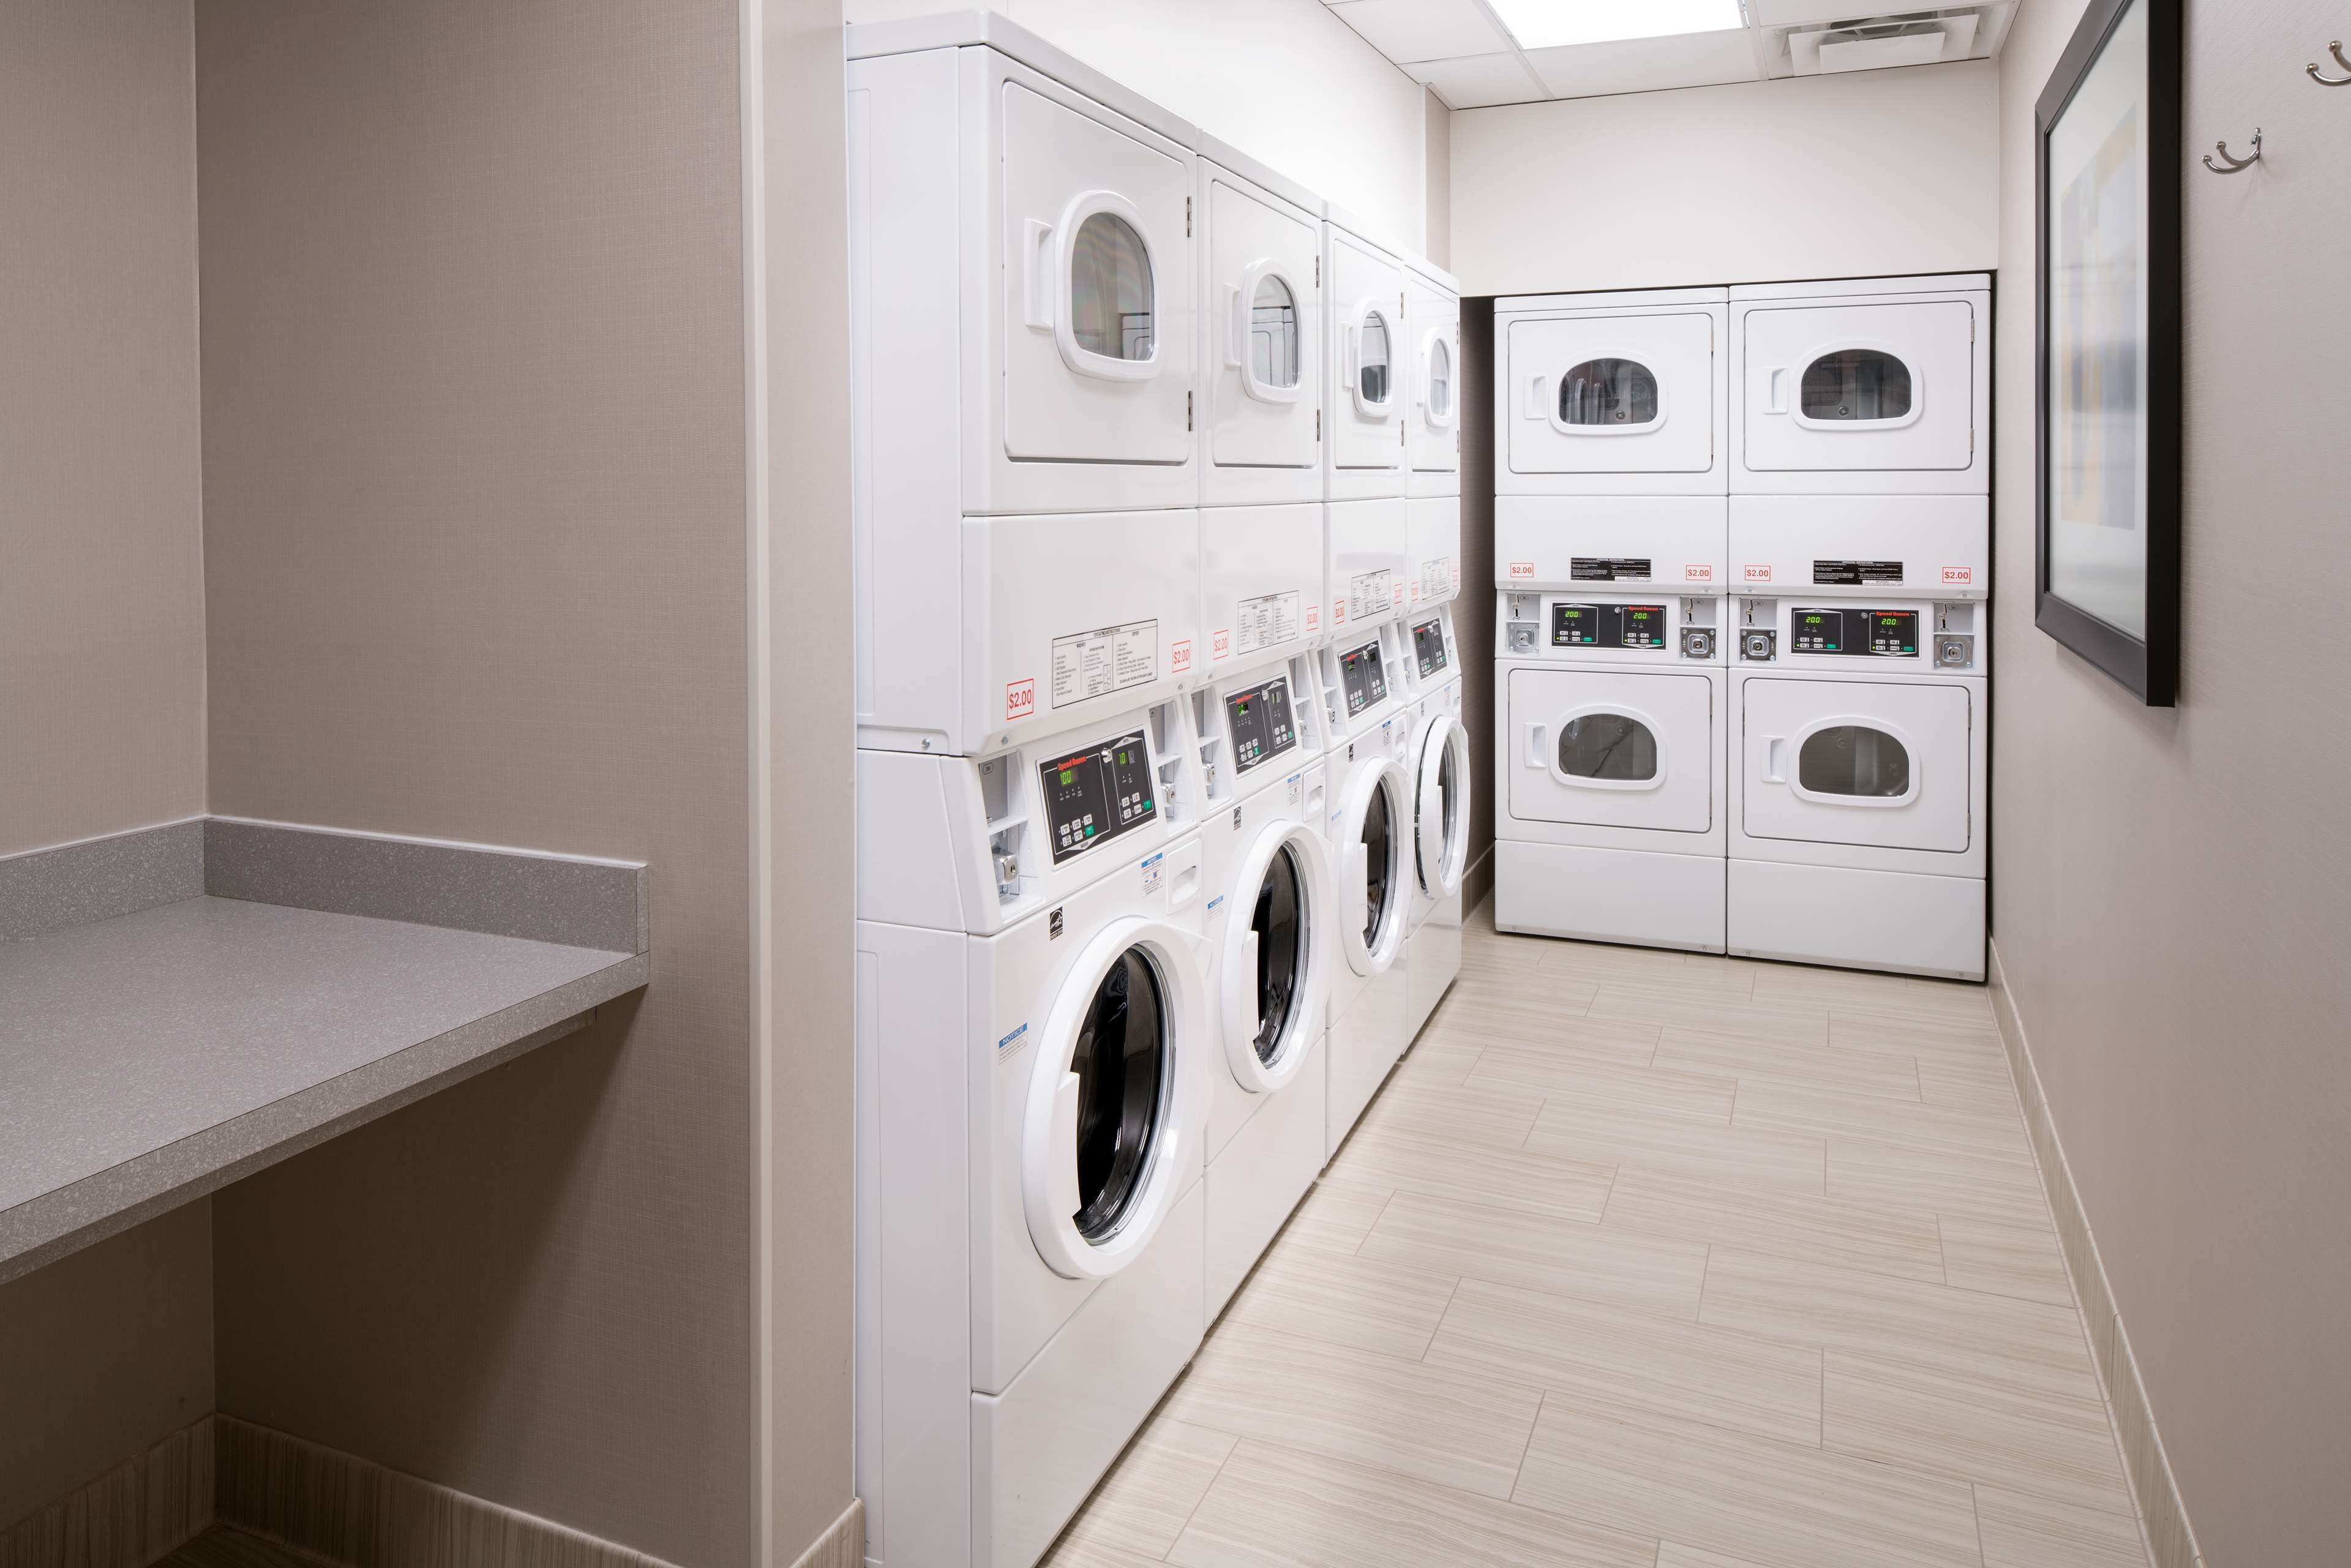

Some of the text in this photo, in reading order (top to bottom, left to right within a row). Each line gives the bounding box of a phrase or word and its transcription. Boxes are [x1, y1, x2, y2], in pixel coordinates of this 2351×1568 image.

[1746, 569, 1769, 577] $2.00
[1944, 571, 1969, 579] $2.00
[1307, 612, 1317, 625] $2.00
[1215, 637, 1228, 652] $2.00
[1173, 648, 1190, 664] $2.00
[1008, 689, 1032, 710] $2.00
[1057, 756, 1087, 771] Speed Queen
[1060, 770, 1071, 784] 100
[1002, 1026, 1025, 1045] NOTICE
